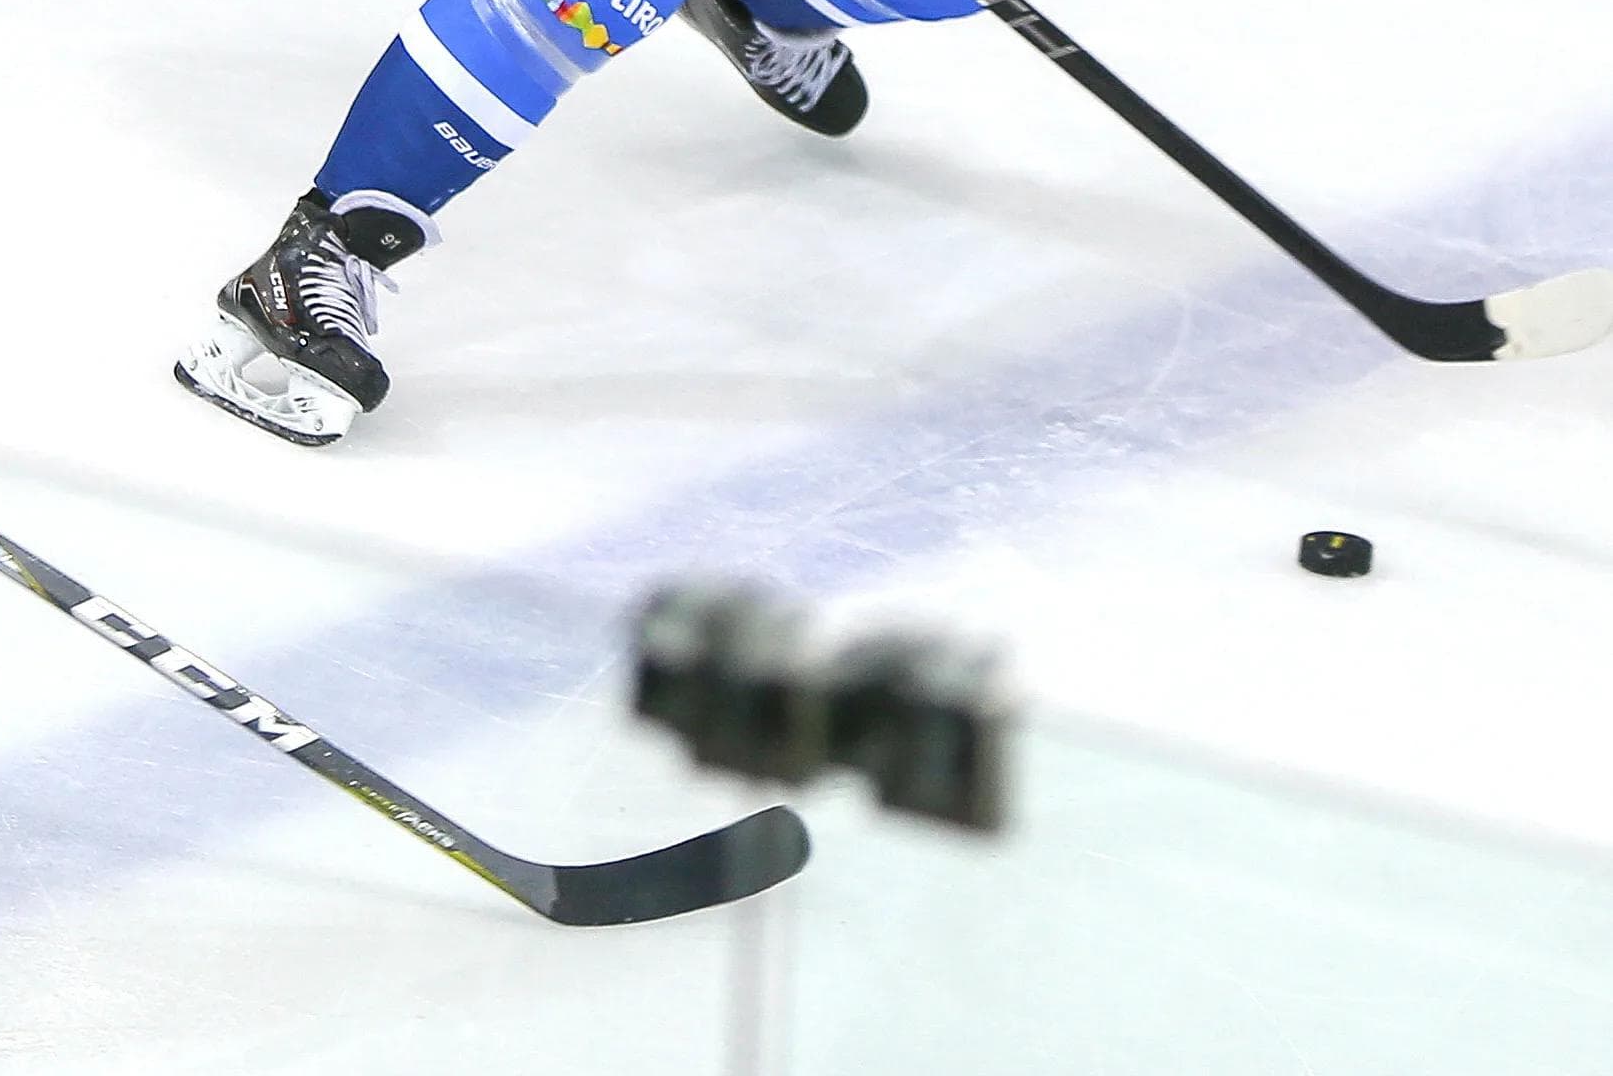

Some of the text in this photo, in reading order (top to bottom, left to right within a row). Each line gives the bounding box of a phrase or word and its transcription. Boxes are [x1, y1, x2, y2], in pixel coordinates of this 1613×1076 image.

[380, 231, 401, 251] 91
[268, 271, 289, 311] CCM
[70, 593, 321, 754] CCM
